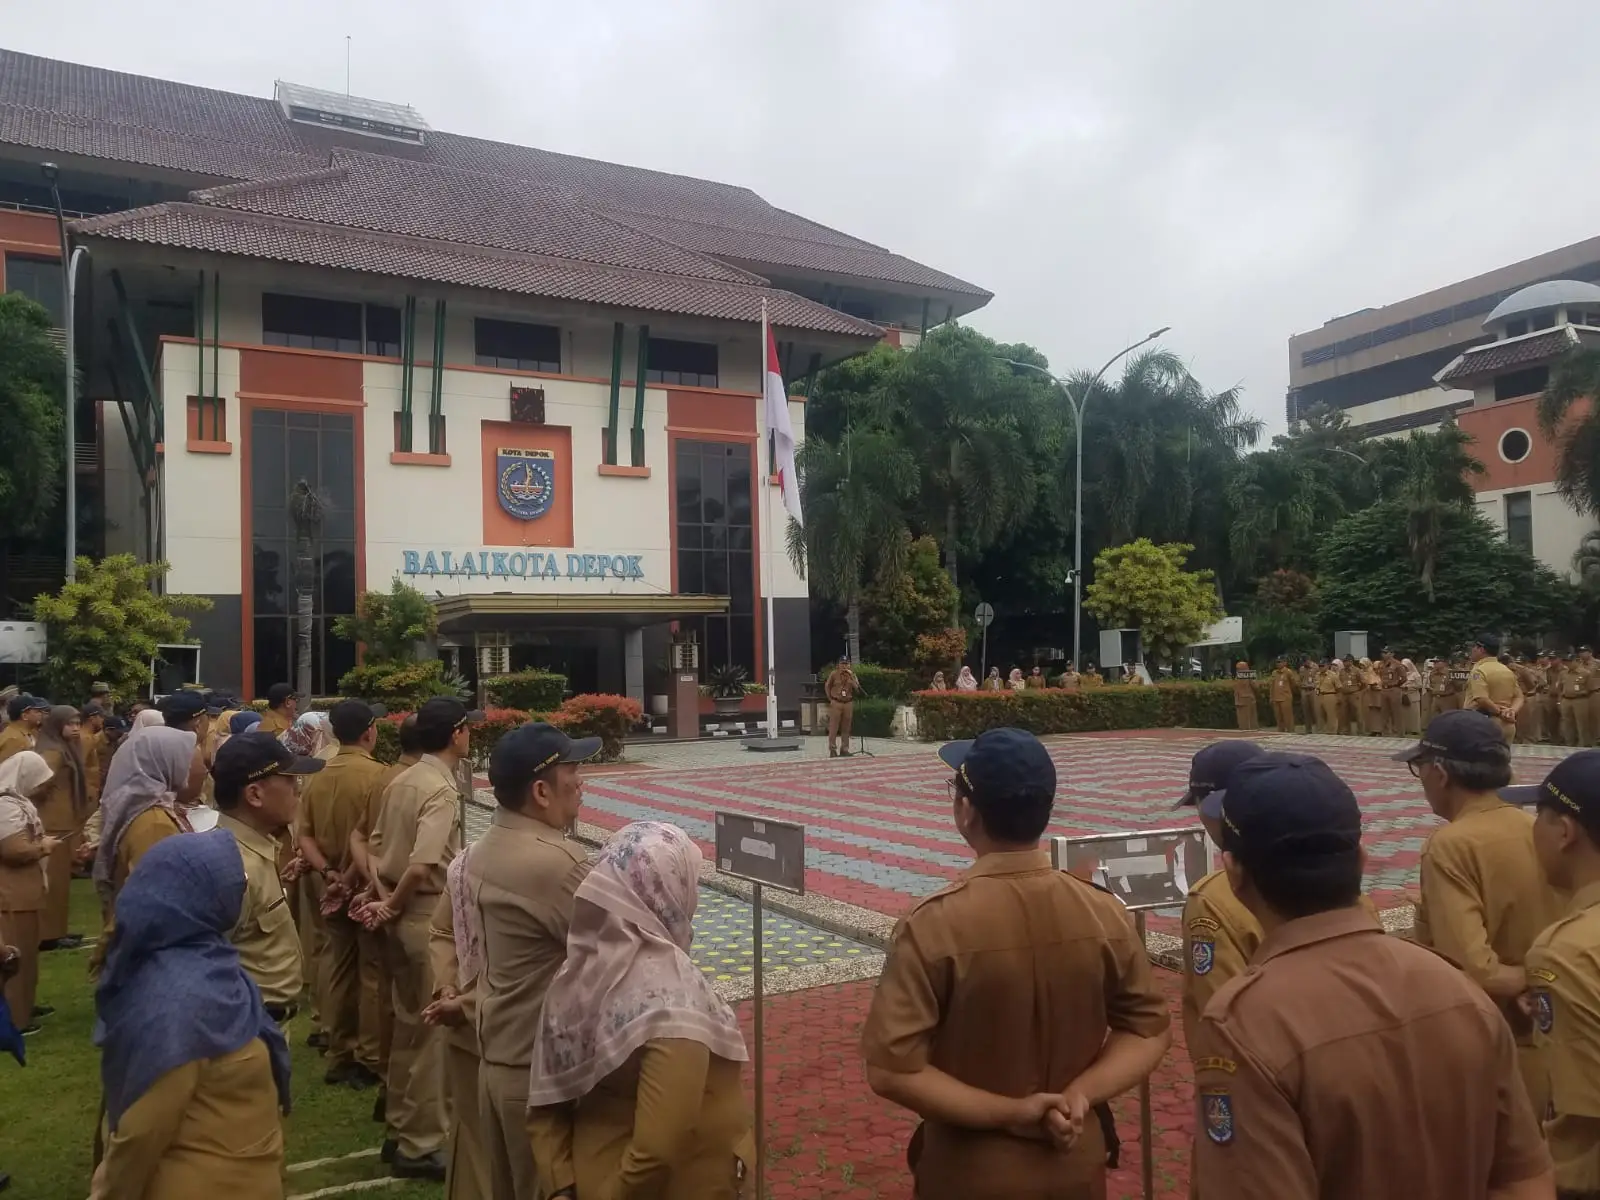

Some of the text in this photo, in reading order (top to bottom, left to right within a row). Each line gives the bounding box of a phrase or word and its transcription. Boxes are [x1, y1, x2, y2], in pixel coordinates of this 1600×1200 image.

[502, 448, 550, 458] KOTA DEPOK
[566, 553, 645, 578] DEPOK
